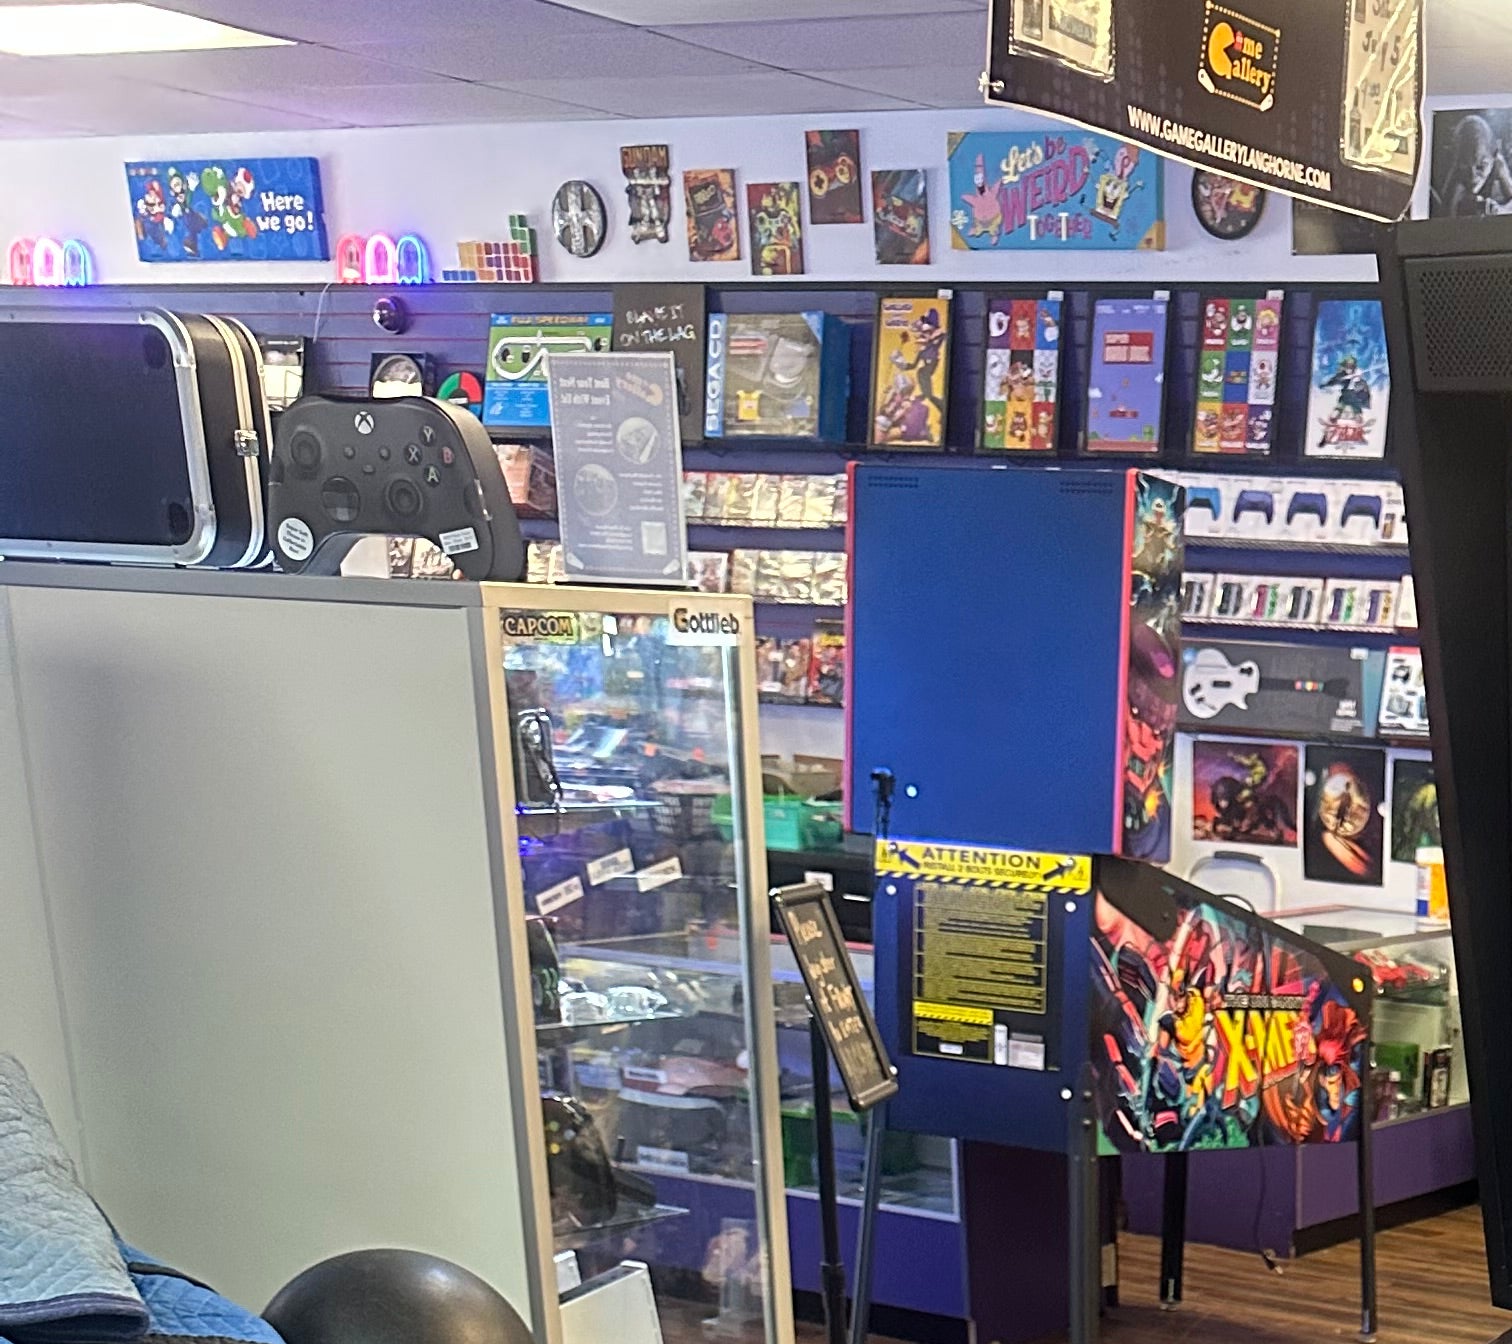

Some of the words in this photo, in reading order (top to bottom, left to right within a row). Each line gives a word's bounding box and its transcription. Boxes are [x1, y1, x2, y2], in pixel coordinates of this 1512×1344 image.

[1001, 141, 1043, 184] Let's
[1044, 136, 1066, 161] be
[1127, 104, 1332, 192] WWW.GAMEGALLERYLANGHORNE.COM
[260, 191, 304, 212] Here
[1001, 146, 1089, 235] WEIRD
[256, 214, 281, 231] we
[284, 211, 314, 234] go!
[1027, 212, 1092, 242] TOGETHER
[707, 320, 723, 358] CD
[706, 362, 723, 431] SEGA
[423, 425, 434, 442] Y
[408, 447, 419, 462] X
[442, 447, 452, 464] B
[427, 466, 439, 482] A
[504, 615, 574, 636] CAPCOM
[674, 608, 739, 634] Gottlieb
[922, 847, 1041, 870] ATTENTION
[923, 861, 956, 872] INSTALL
[966, 864, 993, 876] BOLTS
[1216, 1009, 1316, 1107] X-ME
